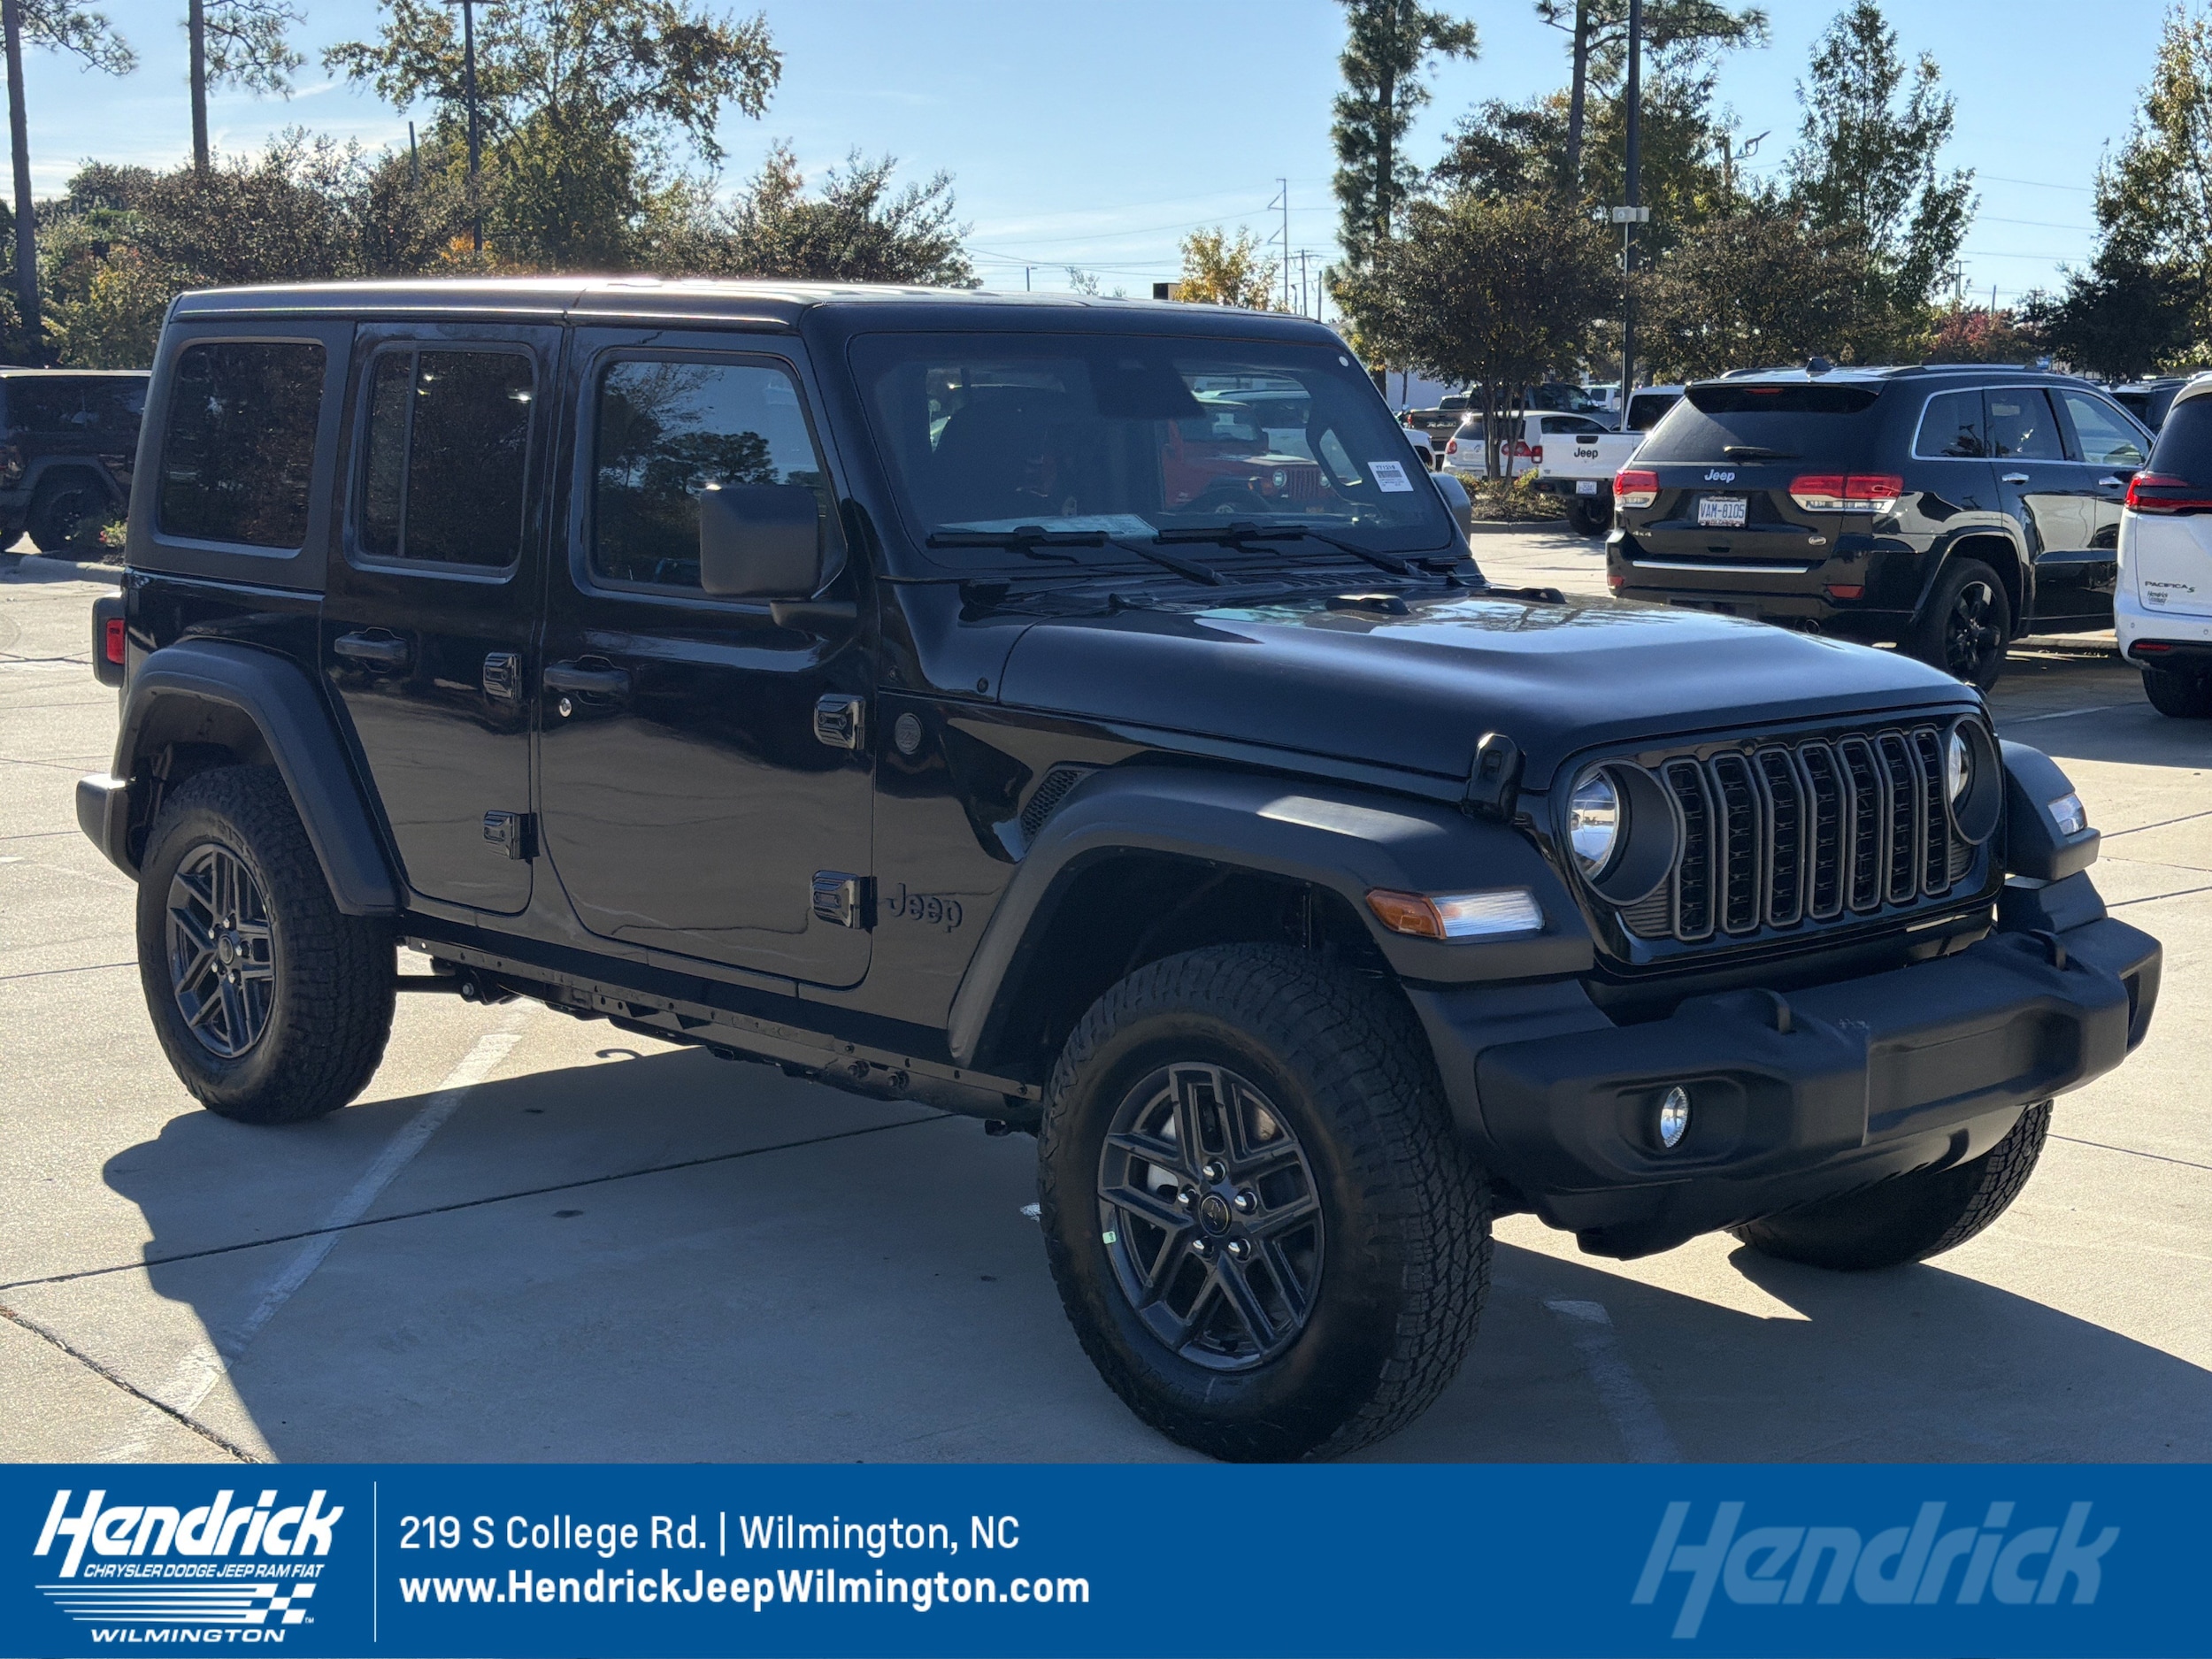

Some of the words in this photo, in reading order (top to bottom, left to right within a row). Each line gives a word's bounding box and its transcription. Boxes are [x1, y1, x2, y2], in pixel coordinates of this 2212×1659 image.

[1573, 447, 1599, 459] Jeep
[1704, 469, 1735, 483] Jeep
[1701, 503, 1745, 518] VAM-8105
[2145, 580, 2188, 589] PACIFICA
[887, 882, 963, 933] Jeep
